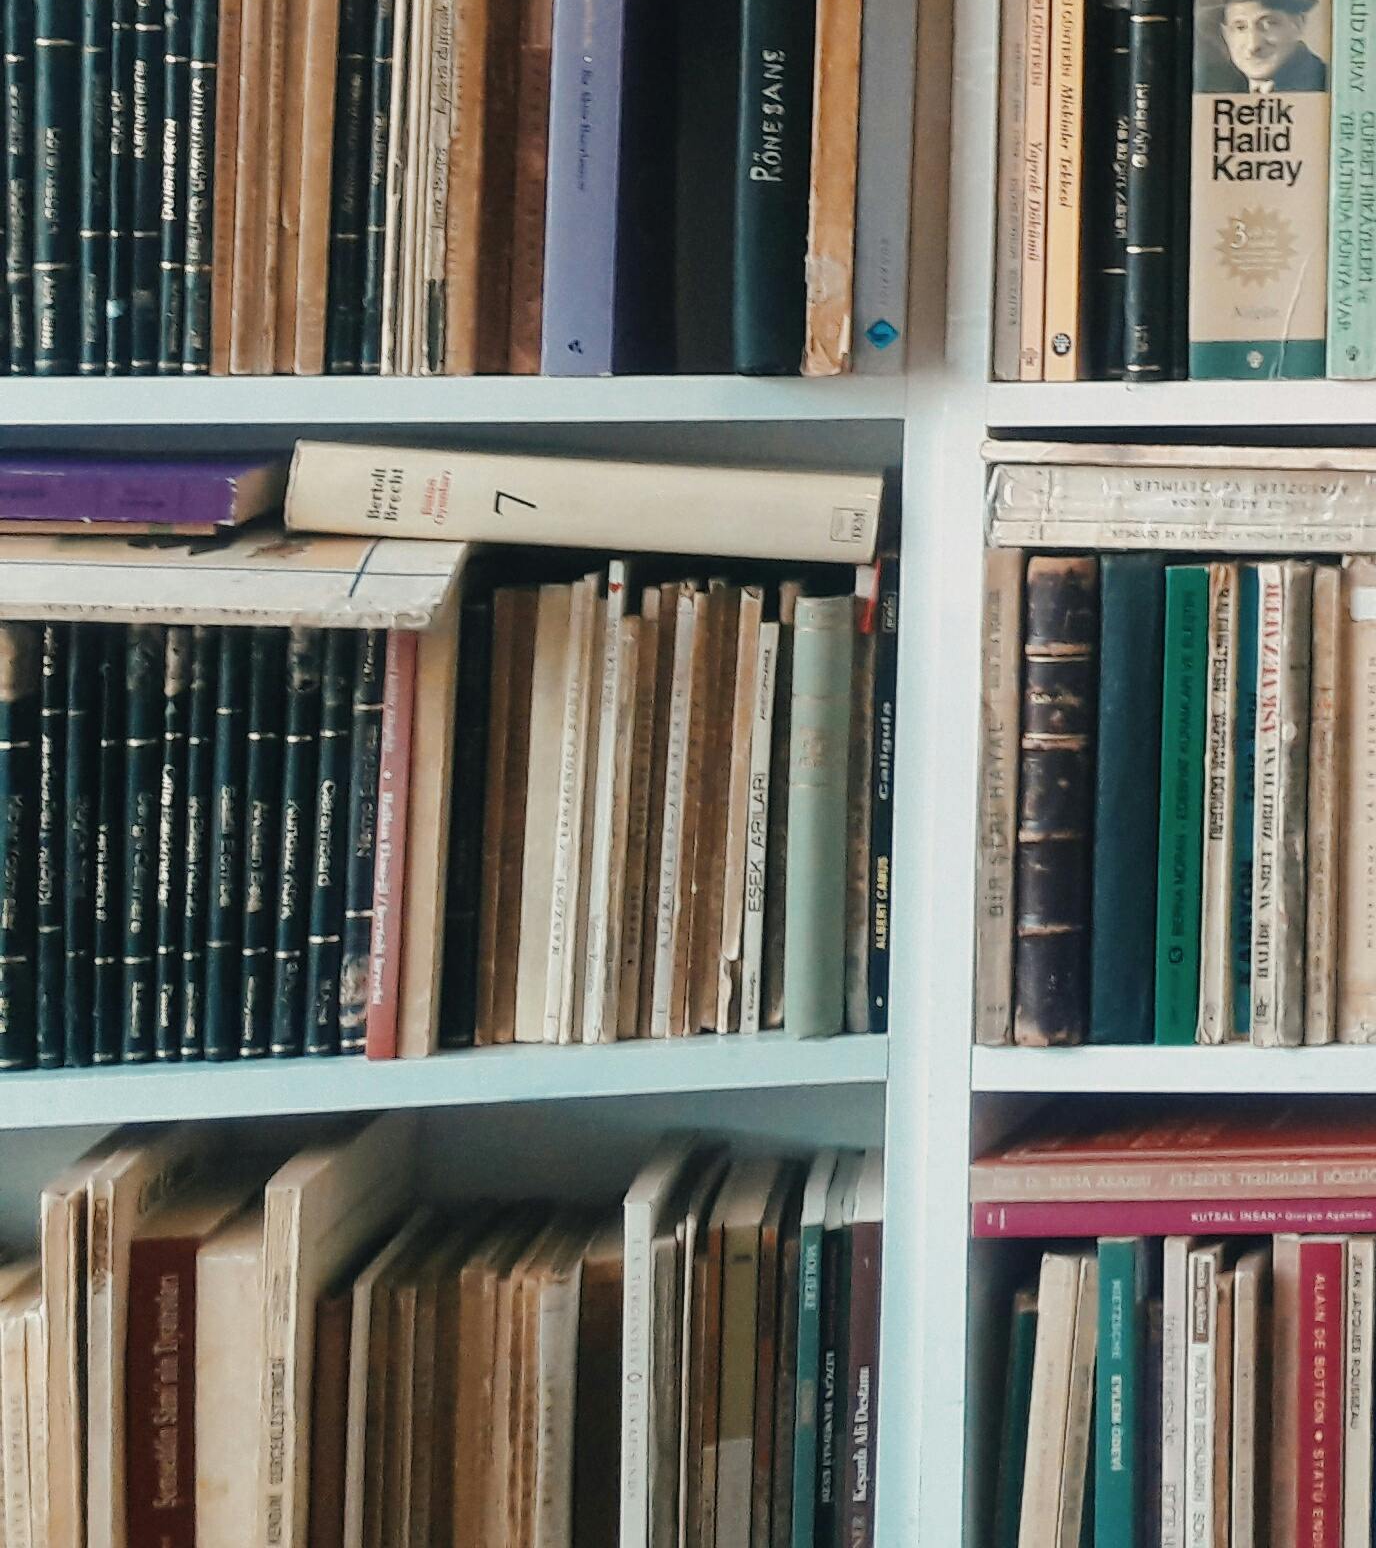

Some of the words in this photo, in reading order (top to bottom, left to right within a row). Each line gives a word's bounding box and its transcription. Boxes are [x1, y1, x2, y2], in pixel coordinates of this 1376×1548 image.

[748, 49, 787, 182] RÖNESANS
[1212, 97, 1294, 126] Refik
[1213, 126, 1292, 155] Halid
[1212, 159, 1303, 187] Karay
